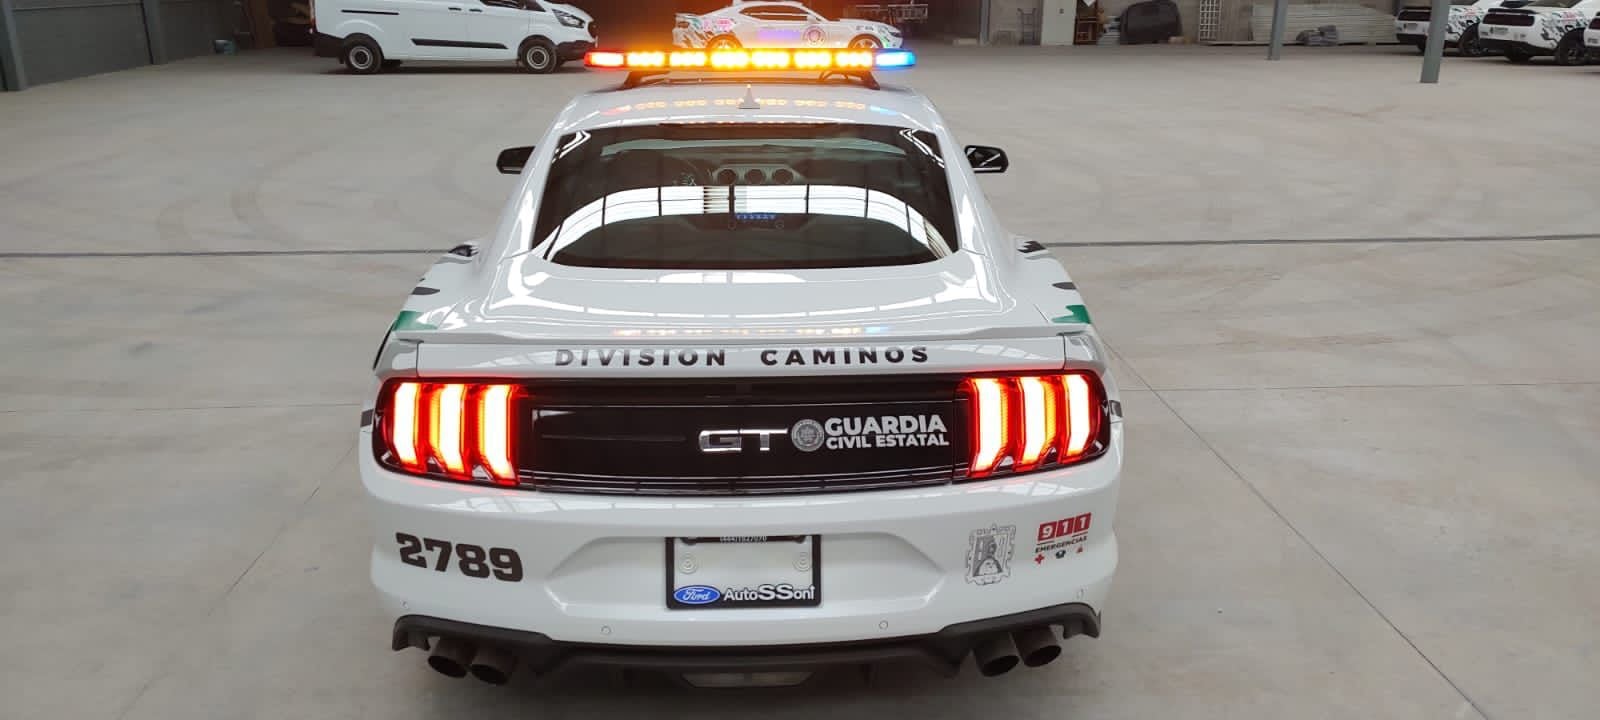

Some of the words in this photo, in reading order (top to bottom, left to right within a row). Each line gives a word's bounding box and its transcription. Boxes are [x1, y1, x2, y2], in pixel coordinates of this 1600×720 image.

[555, 350, 726, 366] DIVISION
[760, 346, 930, 366] CAMINOS
[824, 415, 947, 436] GUARDIA
[699, 428, 788, 452] GT
[826, 435, 871, 450] CIVIL
[877, 432, 949, 447] ESTATAL
[1043, 518, 1086, 538] 911
[1035, 536, 1088, 553] EMERGENCIAS
[396, 532, 523, 582] 2789
